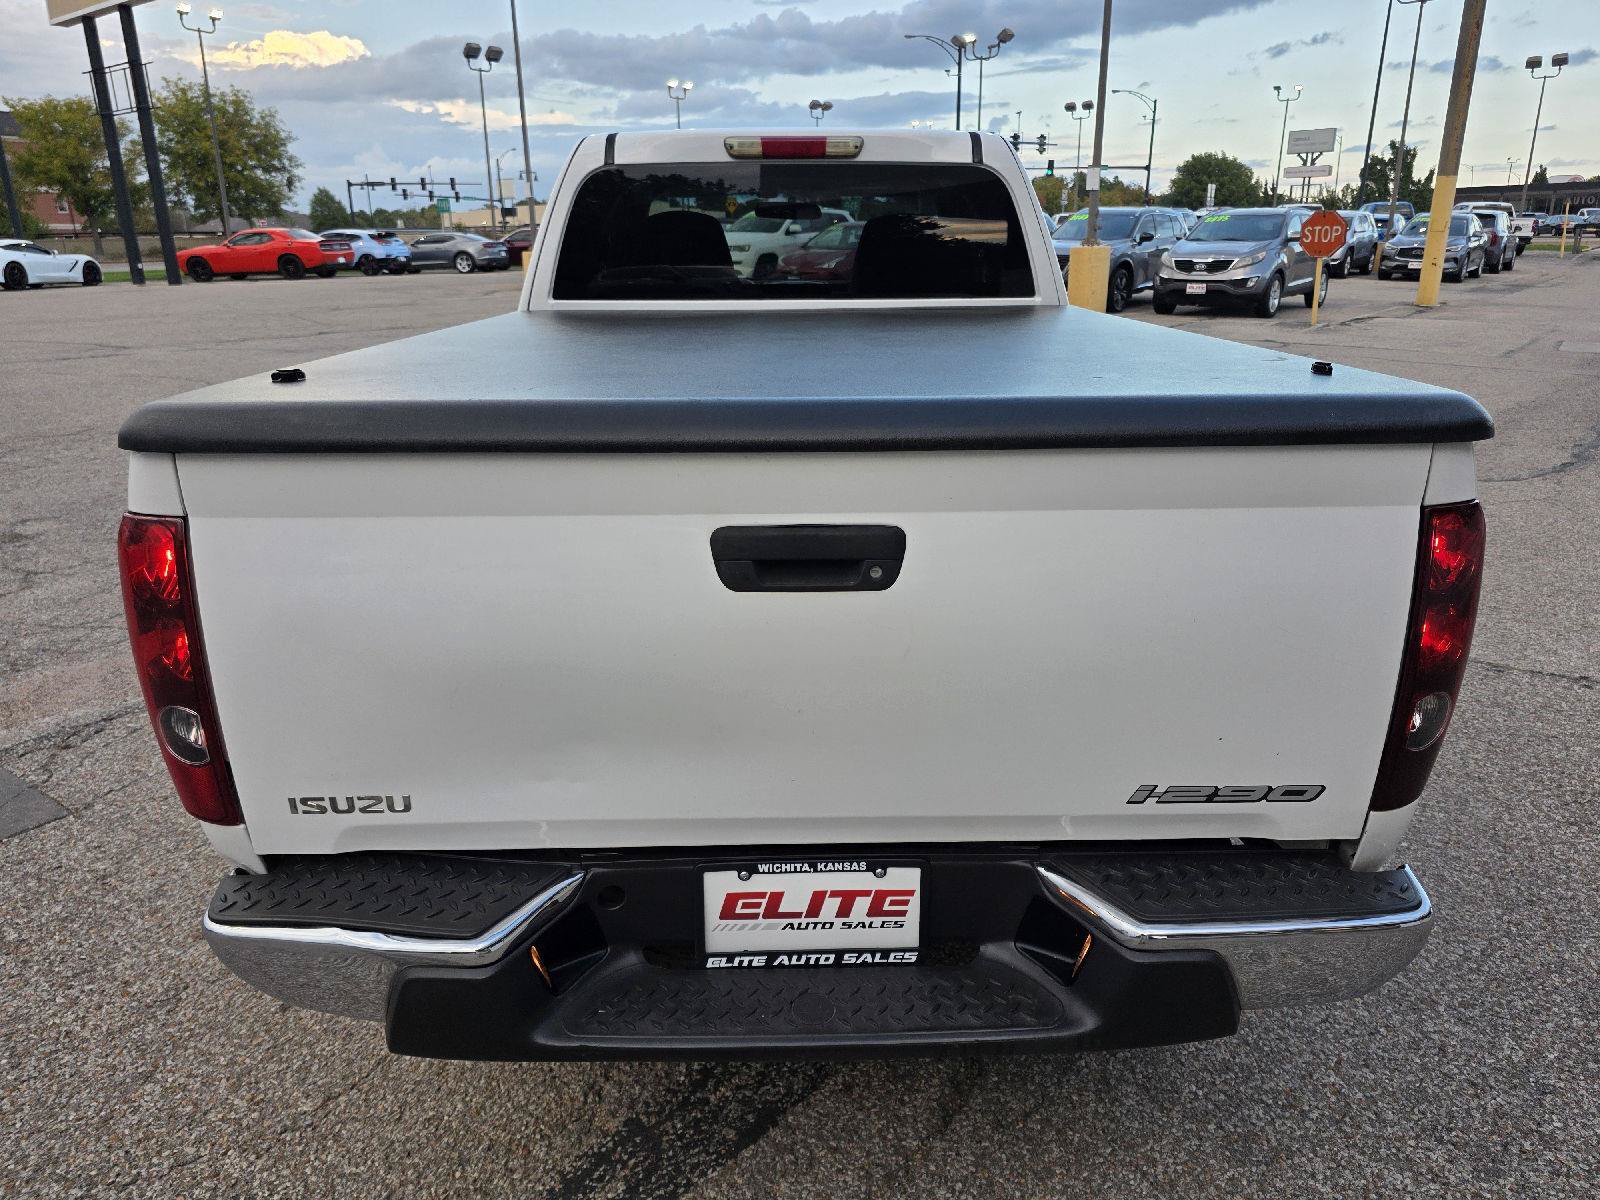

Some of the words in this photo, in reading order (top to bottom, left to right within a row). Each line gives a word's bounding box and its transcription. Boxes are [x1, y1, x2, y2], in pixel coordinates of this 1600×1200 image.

[1302, 226, 1342, 243] STOP
[287, 794, 412, 814] ISUZU
[757, 863, 814, 873] WICHITA,
[817, 861, 867, 872] KANSAS
[718, 889, 917, 920] ELITE
[781, 921, 835, 931] AUTO
[839, 920, 906, 930] SALES
[705, 955, 768, 969] ELITE
[773, 954, 836, 966] AUTO
[841, 951, 919, 964] SALES
